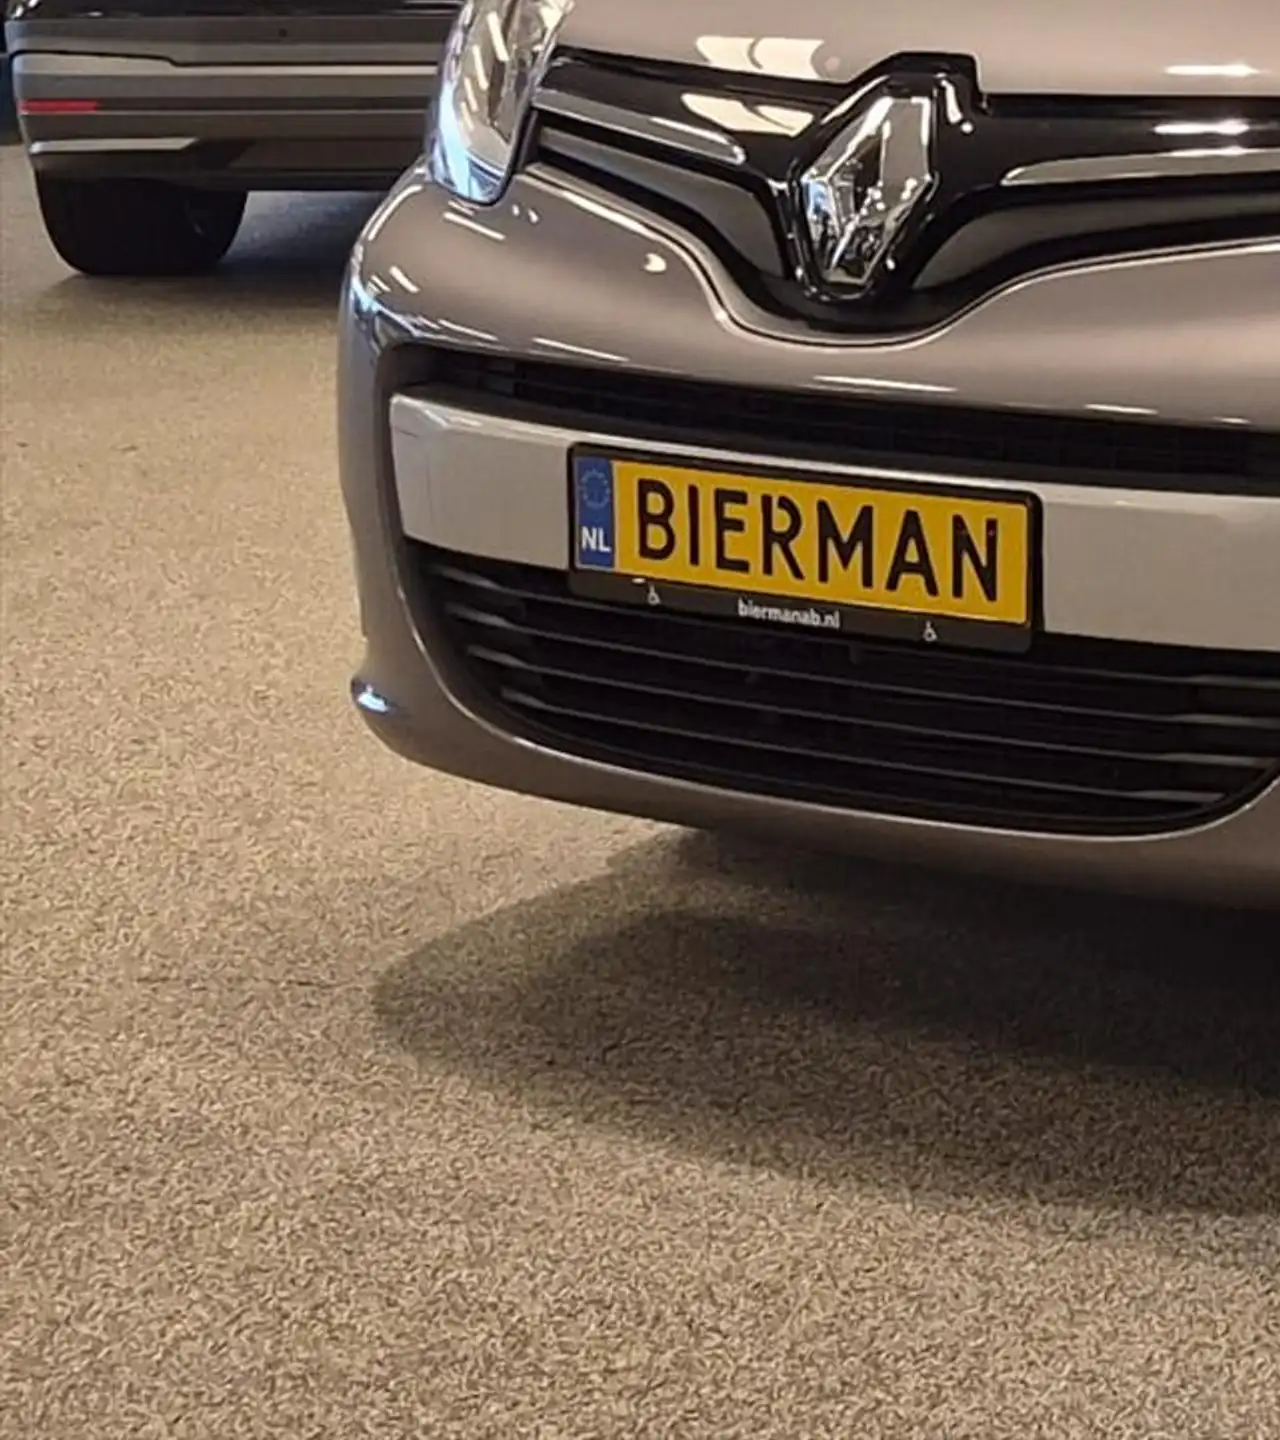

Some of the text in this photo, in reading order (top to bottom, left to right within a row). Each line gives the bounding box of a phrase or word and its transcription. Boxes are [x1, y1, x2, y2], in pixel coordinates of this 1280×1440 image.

[581, 526, 611, 553] NL
[636, 478, 998, 602] BIERMAN
[737, 596, 841, 629] biermanab.nl
